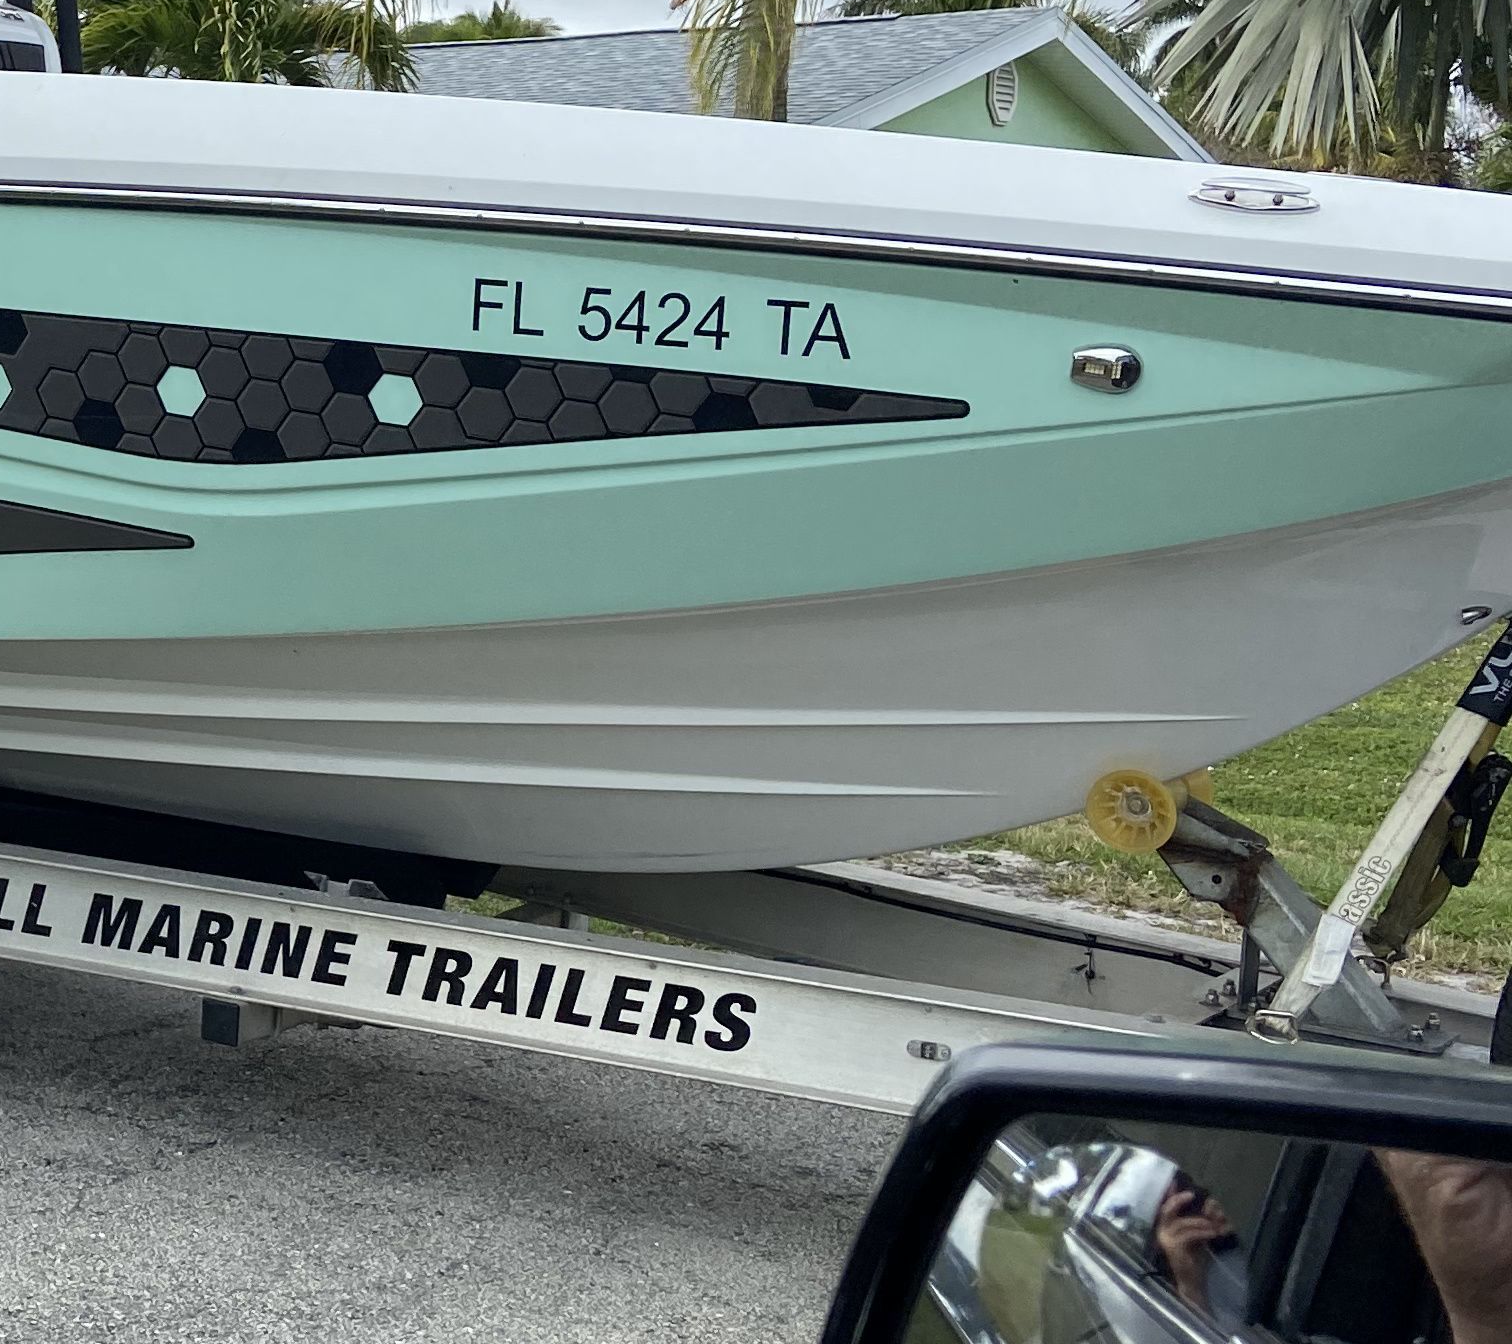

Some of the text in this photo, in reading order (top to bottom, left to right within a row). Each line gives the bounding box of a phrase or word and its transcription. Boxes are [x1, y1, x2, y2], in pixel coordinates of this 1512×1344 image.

[472, 278, 851, 360] FL 5424 TA
[1336, 856, 1392, 925] assic
[81, 892, 359, 987] MARINE
[387, 939, 757, 1052] TRAILERS
